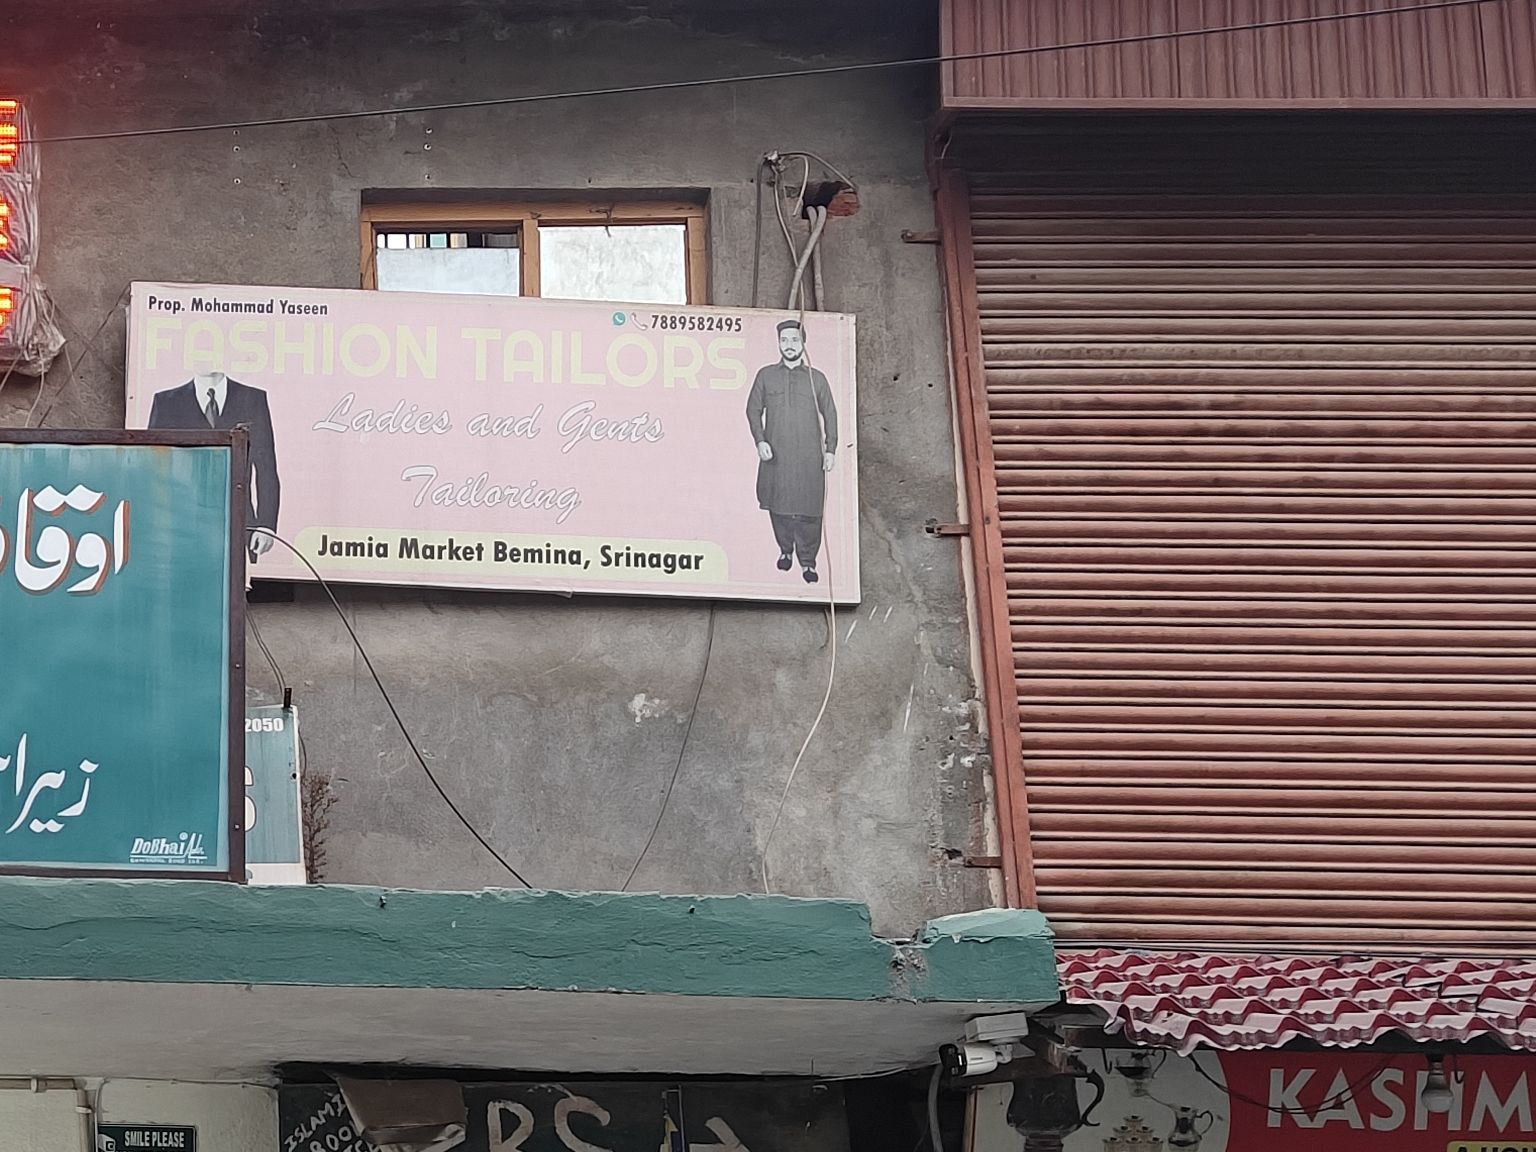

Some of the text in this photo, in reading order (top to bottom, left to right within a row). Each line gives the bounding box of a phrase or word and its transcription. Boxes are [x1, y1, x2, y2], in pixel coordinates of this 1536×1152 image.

[148, 296, 328, 315] Prop. Mohammad Yaseen
[651, 313, 742, 332] 7889582495
[145, 317, 748, 390] FASHION TAILORS
[312, 392, 664, 454] Ladies and Gents
[401, 465, 581, 524] Tailoring
[317, 534, 704, 574] Jamia Market Bemina, Srinagar
[124, 1131, 185, 1148] SMILE PLEASE
